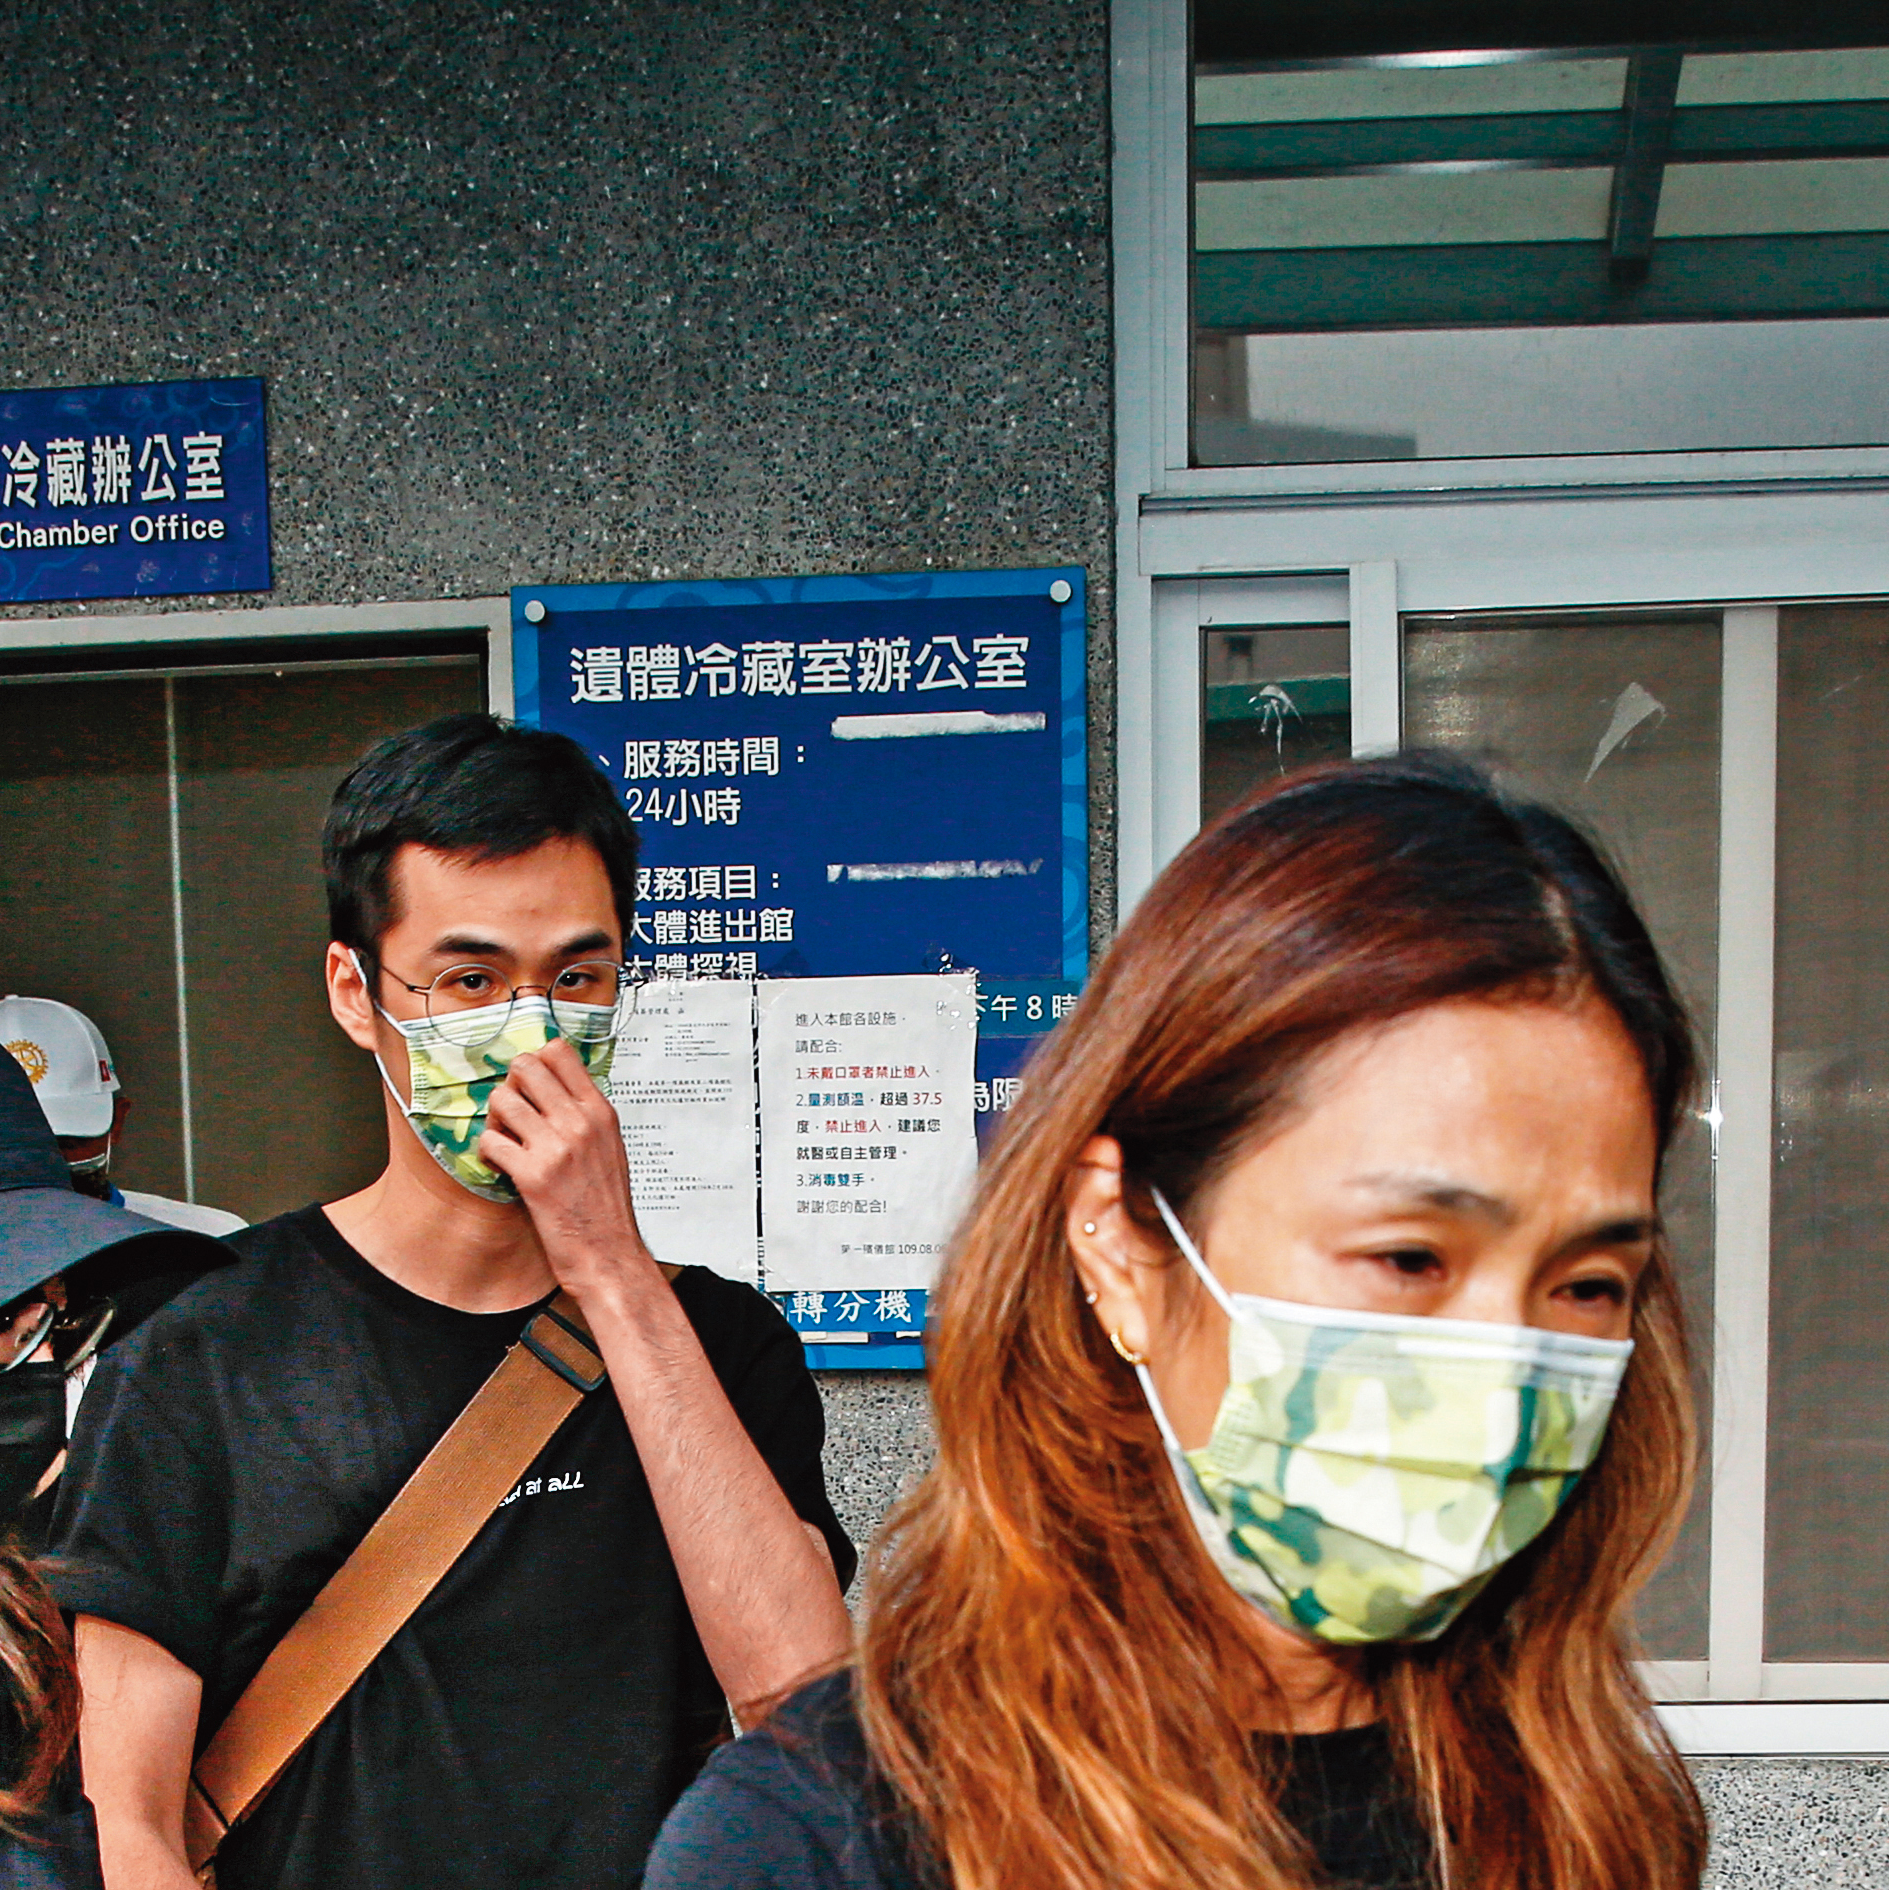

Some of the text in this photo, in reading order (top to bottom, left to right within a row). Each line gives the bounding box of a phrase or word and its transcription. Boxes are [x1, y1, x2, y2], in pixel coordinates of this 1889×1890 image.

[130, 513, 225, 542] Office
[569, 634, 1030, 704] 遺體冷藏室辦公室
[625, 787, 741, 826] 24小時
[912, 1092, 943, 1106] 37.5
[790, 1290, 912, 1324] 轉分機
